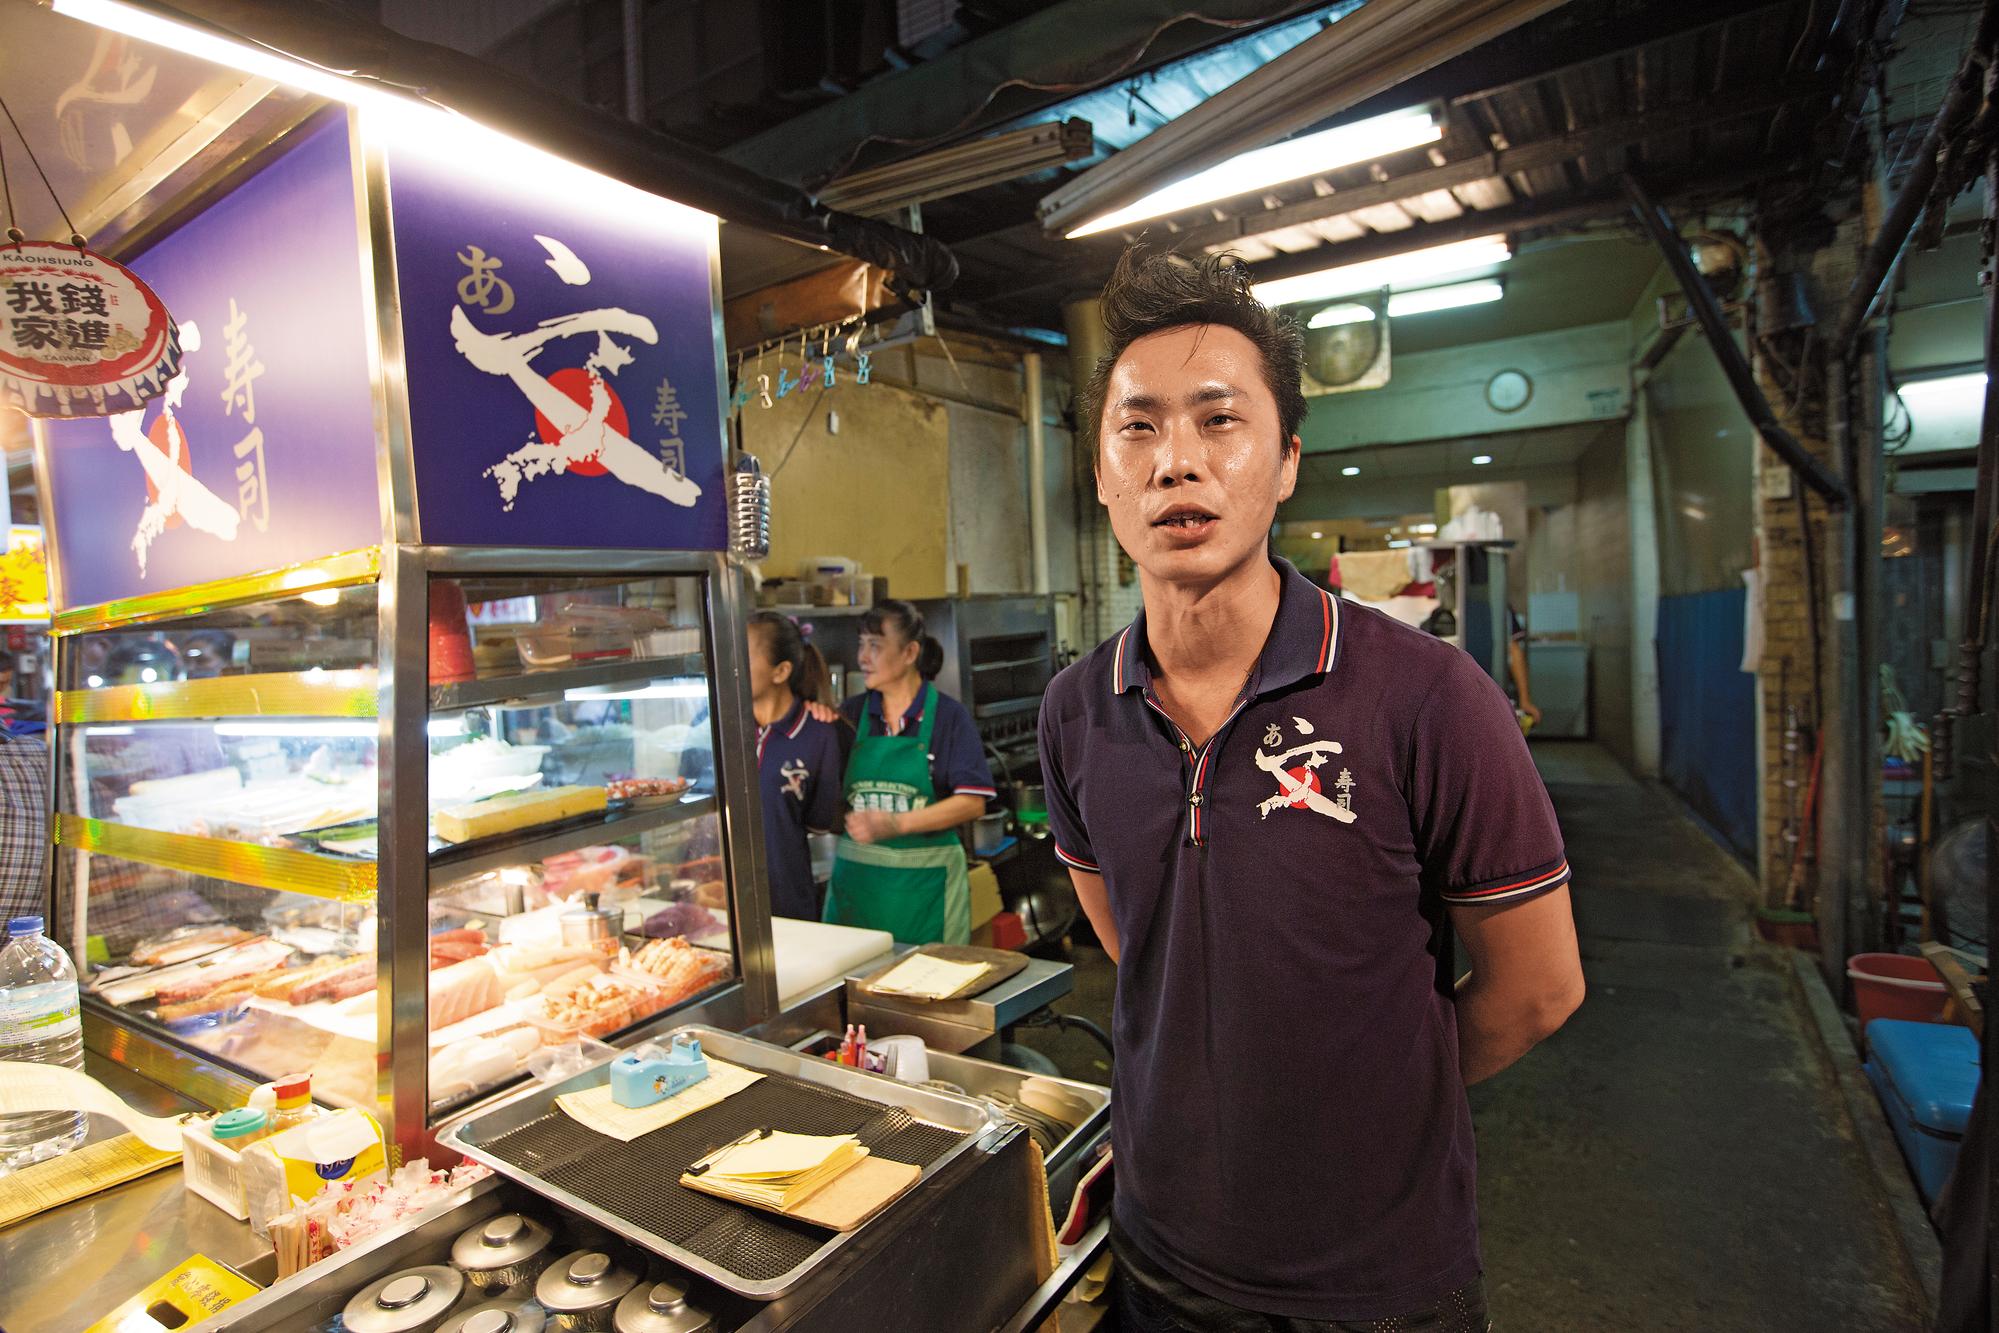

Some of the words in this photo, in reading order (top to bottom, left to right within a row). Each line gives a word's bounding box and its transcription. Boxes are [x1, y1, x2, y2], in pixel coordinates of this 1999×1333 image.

[3, 253, 94, 267] KAOHSIUNG
[457, 245, 515, 314] あ
[44, 354, 91, 362] TAIWAN
[221, 297, 269, 533] 寿司
[652, 378, 687, 482] 寿司
[1263, 723, 1282, 747] あ
[1334, 767, 1356, 812] 寿司
